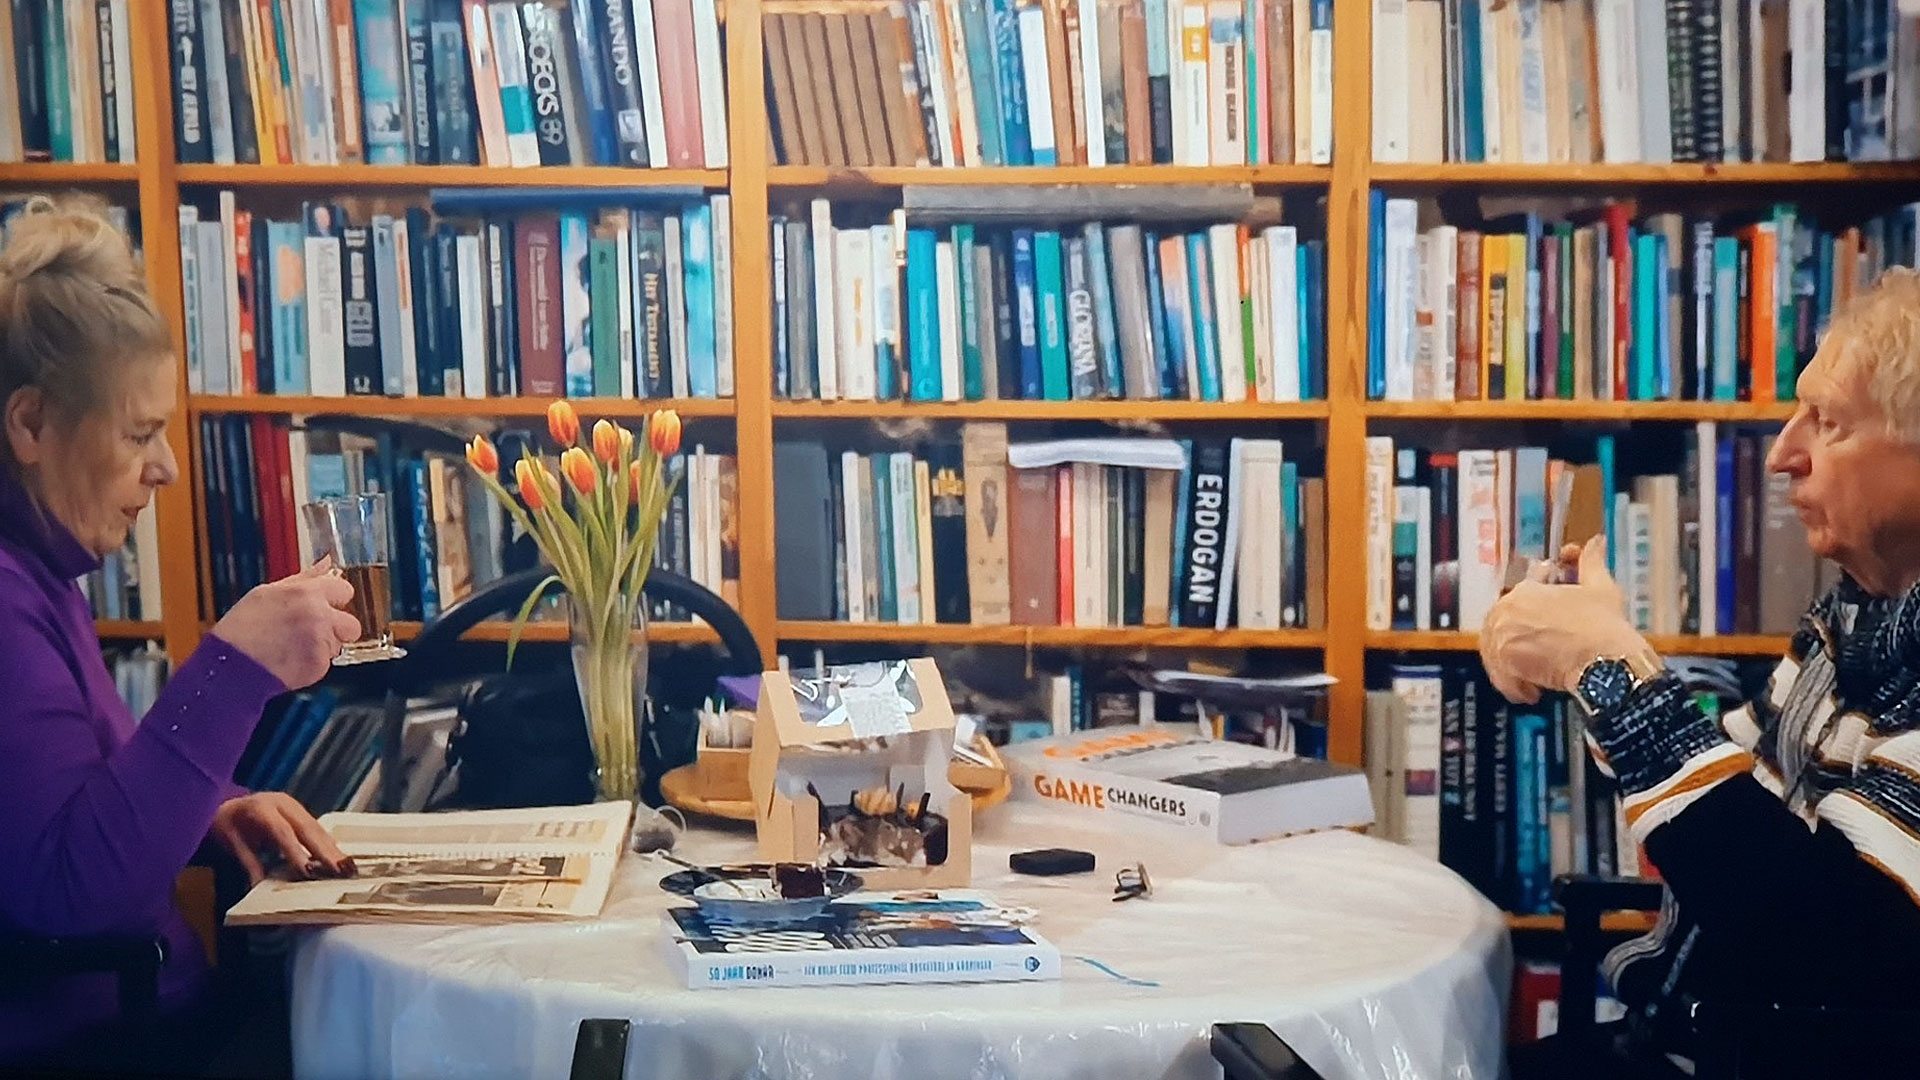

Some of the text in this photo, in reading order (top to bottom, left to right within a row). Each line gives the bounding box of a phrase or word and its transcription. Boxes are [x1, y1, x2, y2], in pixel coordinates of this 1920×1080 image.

[1188, 473, 1224, 604] ERDOGAN
[1033, 774, 1187, 818] GAME CHANGERS
[745, 964, 775, 980] DONAR
